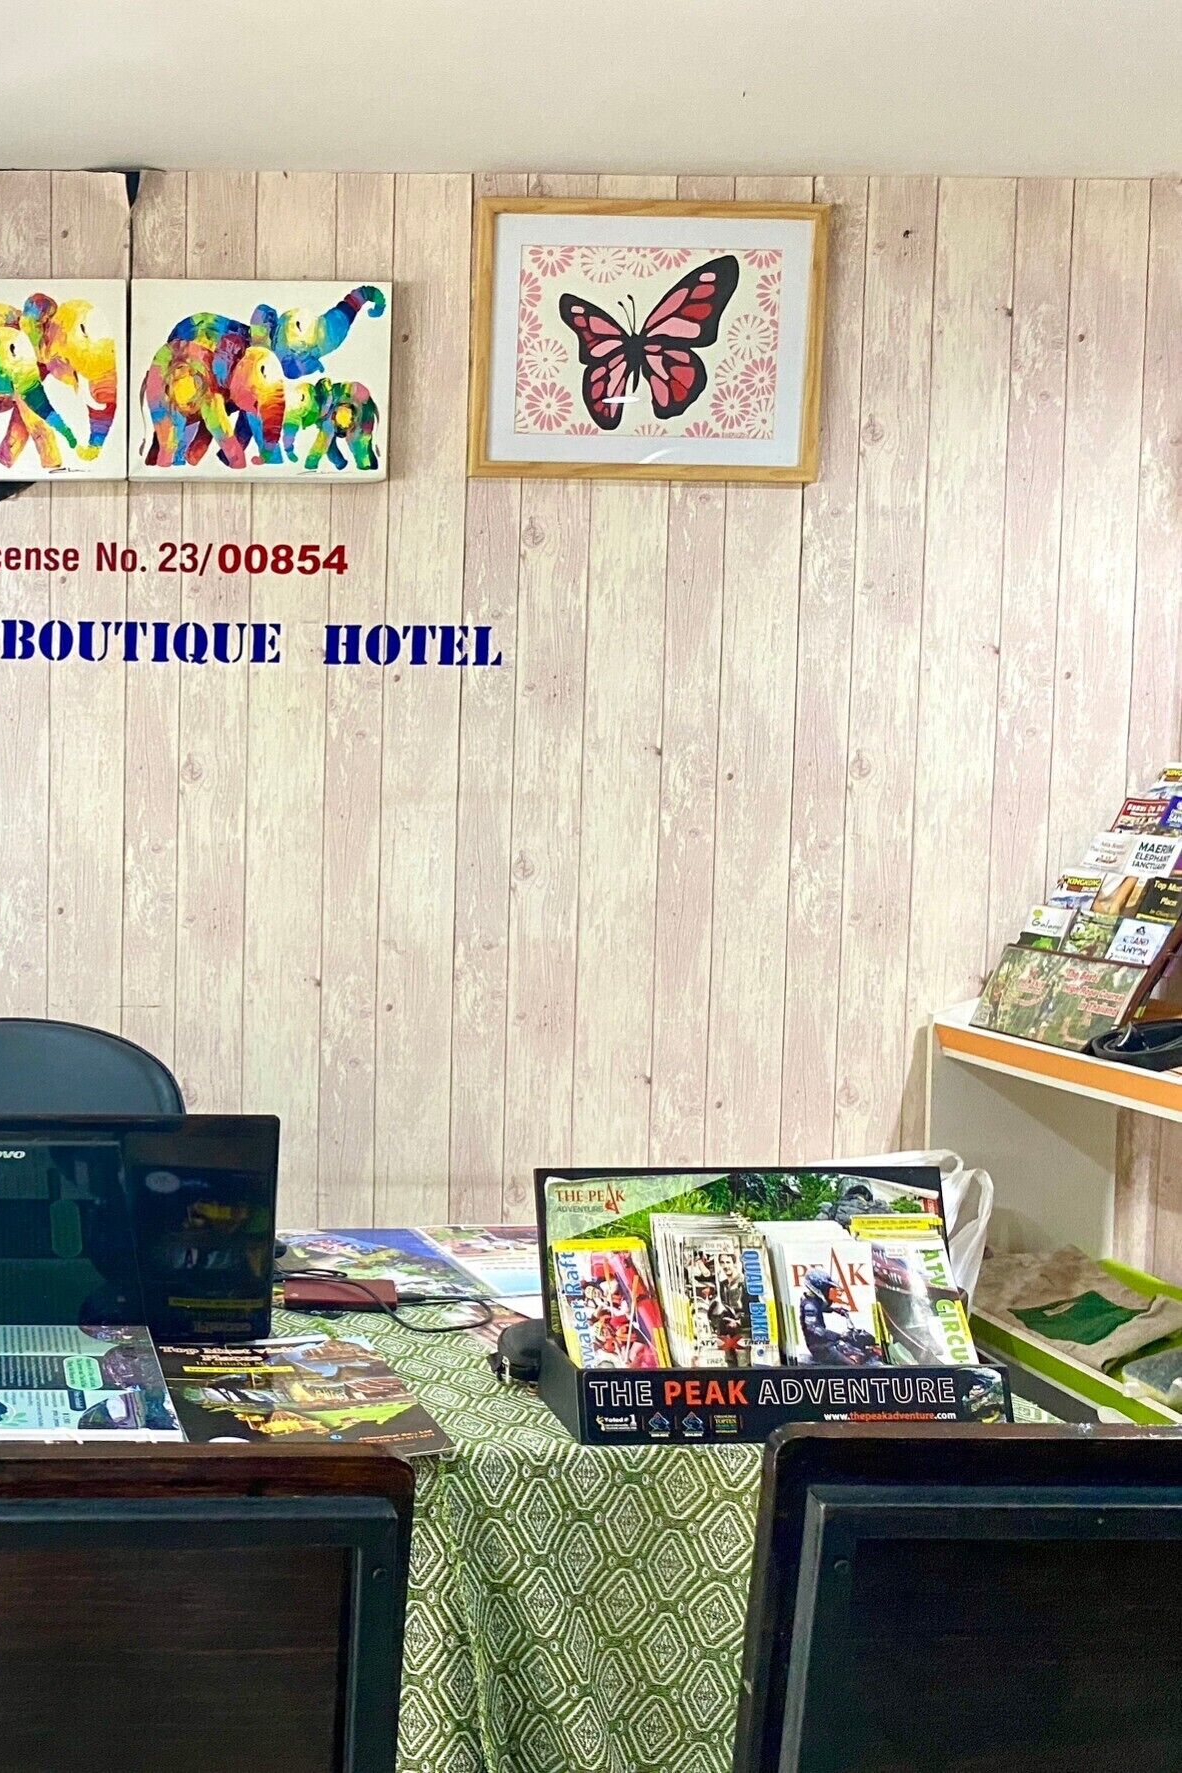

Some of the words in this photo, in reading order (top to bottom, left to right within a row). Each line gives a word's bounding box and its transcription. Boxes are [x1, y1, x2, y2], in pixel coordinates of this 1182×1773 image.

[96, 542, 147, 572] No.
[158, 542, 348, 576] 23/00854
[1, 619, 281, 665] BOUTIQUE
[323, 624, 502, 666] HOTEL
[555, 1189, 583, 1202] THE
[556, 1205, 605, 1213] ADVENTURE
[740, 1250, 764, 1296] QUAD
[792, 1246, 869, 1312] PAK
[749, 1301, 769, 1341] BIKE
[589, 1381, 653, 1406] THE
[664, 1380, 748, 1405] PEAK
[758, 1378, 956, 1404] ADVENTURE
[824, 1411, 957, 1422] www.thepeakadventure.com
